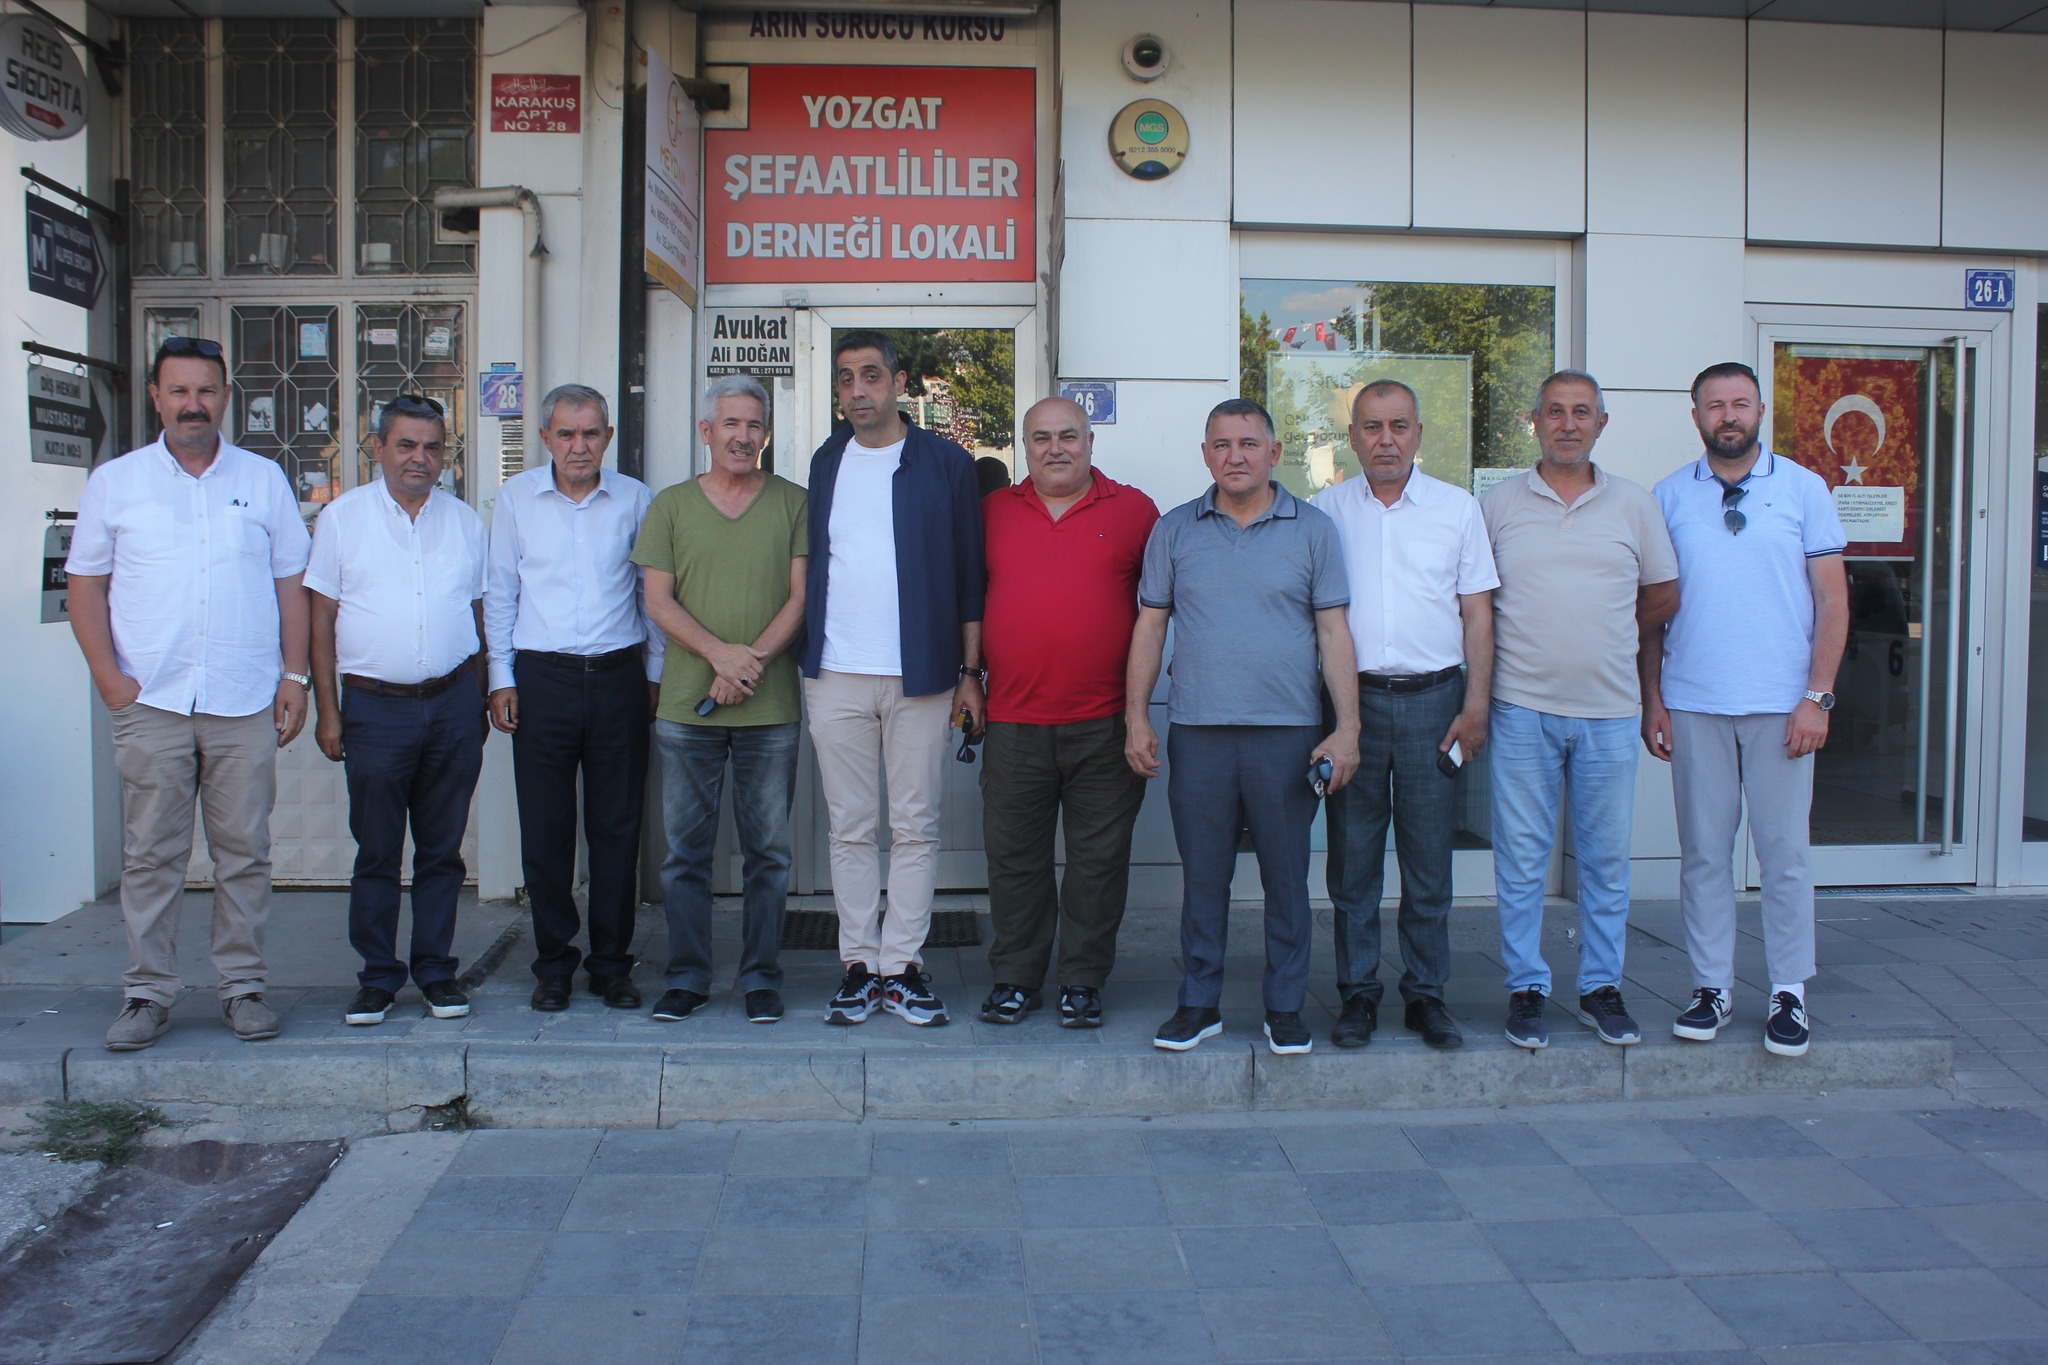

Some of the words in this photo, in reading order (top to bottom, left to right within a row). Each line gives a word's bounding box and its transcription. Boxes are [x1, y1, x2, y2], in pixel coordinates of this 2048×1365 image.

[749, 10, 807, 38] ARIN
[922, 13, 1005, 42] KURSU
[495, 96, 576, 111] KARAKUŞ
[516, 110, 551, 120] APT
[802, 95, 943, 130] YOZGAT
[504, 121, 530, 131] NO
[546, 121, 567, 132] 28
[1139, 123, 1165, 133] MGS
[724, 148, 1019, 201] ŞEFAATLİLİLER
[726, 216, 881, 259] DERNEĞİ
[891, 218, 1015, 260] LOKALİ
[1975, 279, 2005, 302] 26-A
[713, 314, 787, 339] Avukat
[711, 346, 731, 362] Ali
[736, 343, 790, 363] DOĞAN
[499, 384, 517, 409] 28
